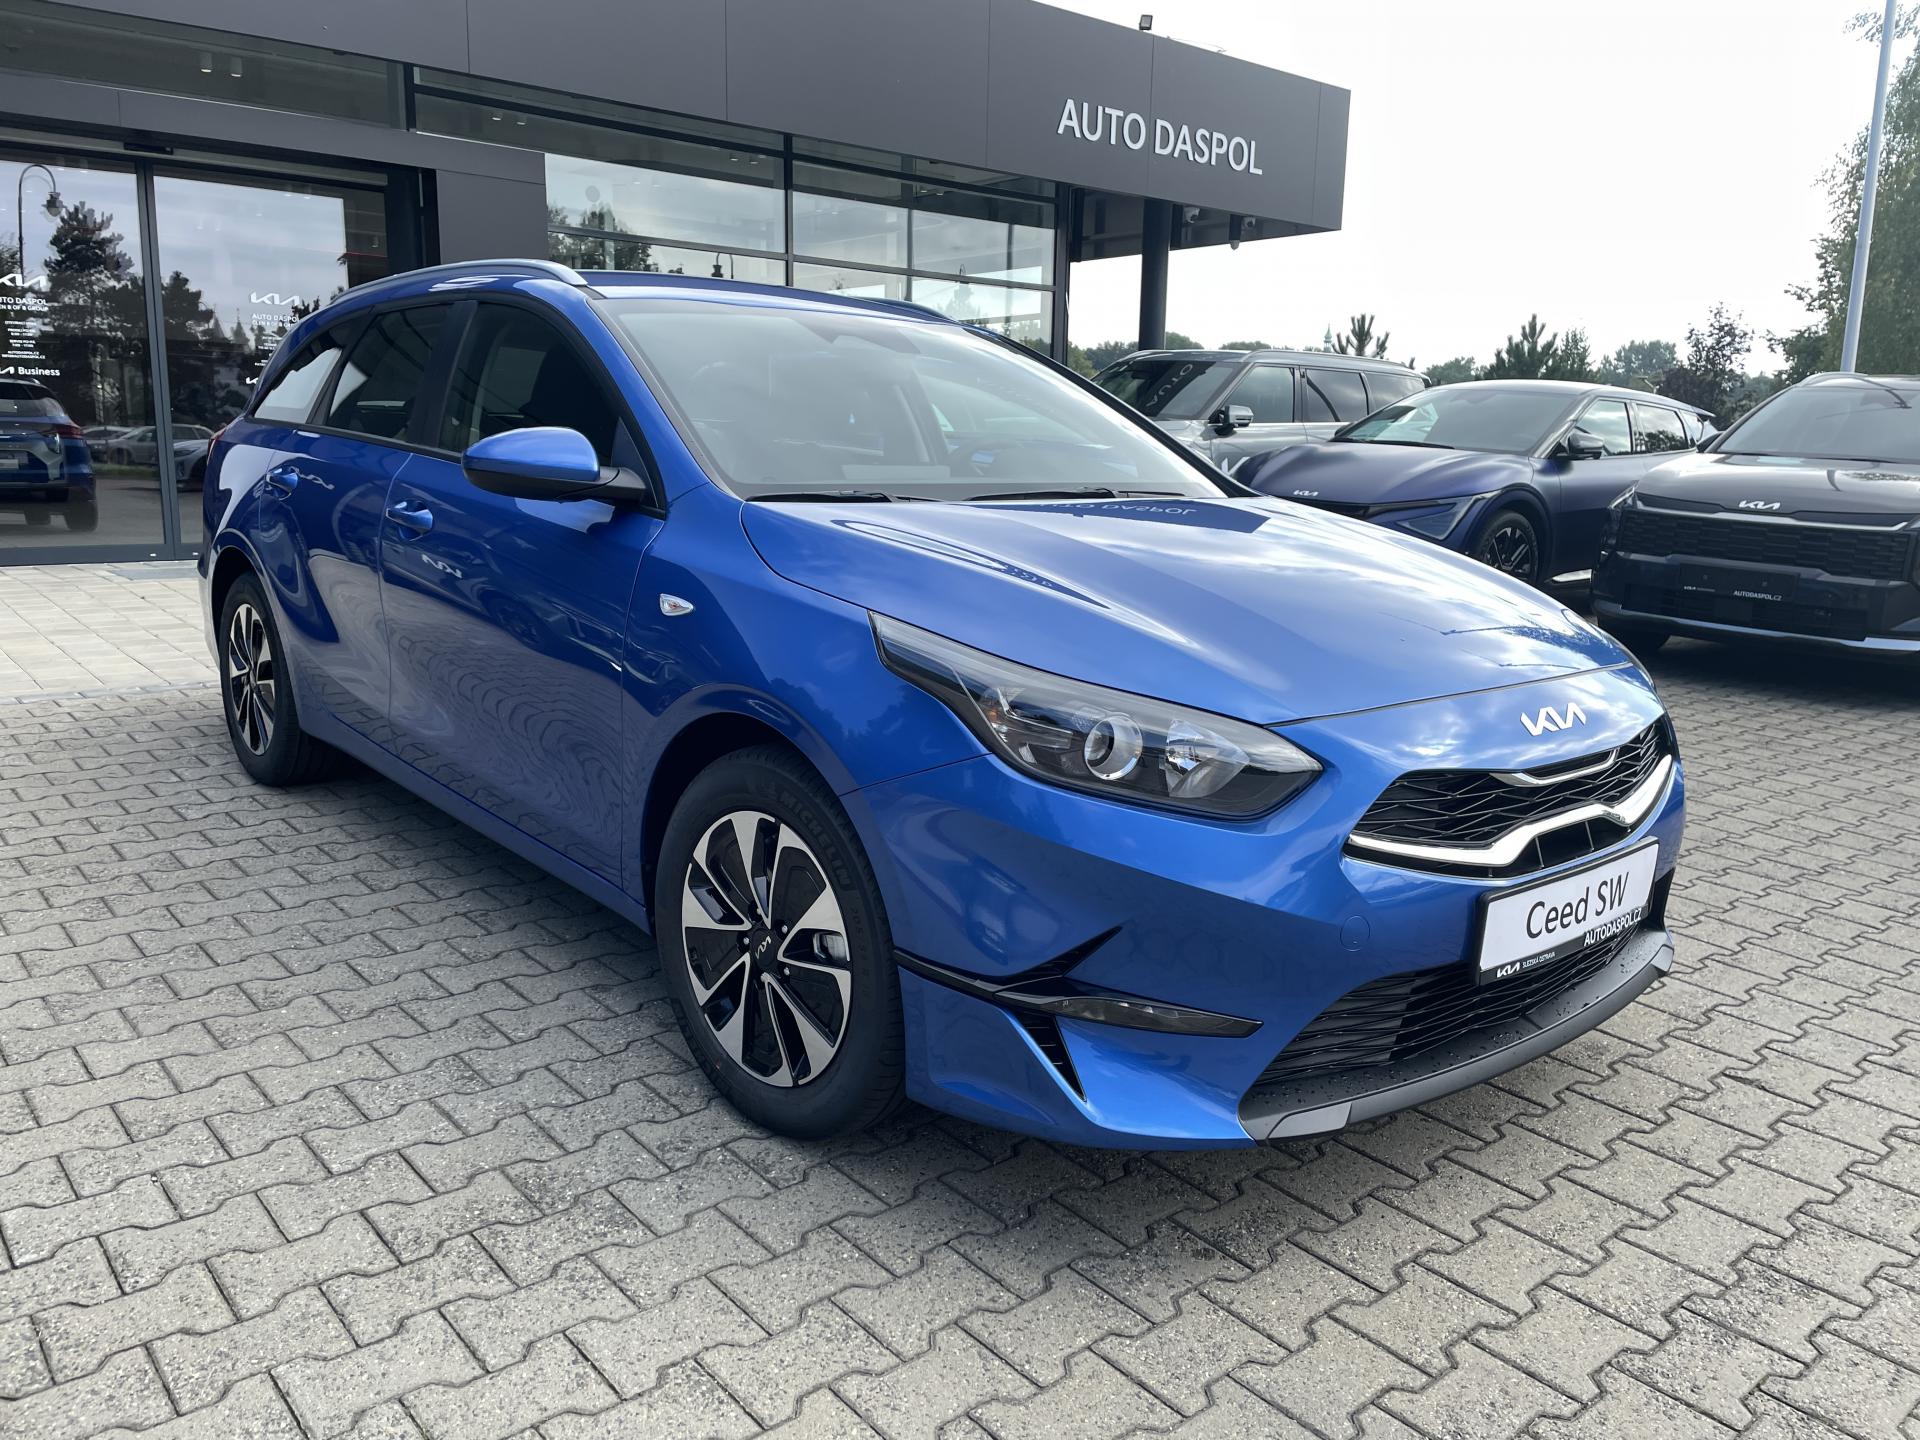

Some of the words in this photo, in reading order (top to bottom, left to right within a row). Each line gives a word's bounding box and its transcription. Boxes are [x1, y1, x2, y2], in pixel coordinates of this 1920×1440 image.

[1057, 98, 1146, 150] AUTO
[1154, 118, 1263, 175] DASPOL
[16, 297, 48, 306] DASPOL
[250, 291, 300, 305] KIA
[252, 313, 272, 321] AUTO
[18, 366, 60, 377] Business
[1293, 489, 1319, 497] KIA
[1739, 500, 1780, 510] KIA
[1520, 702, 1587, 737] KIA
[1526, 886, 1590, 939] Ceed
[1595, 871, 1630, 917] SW
[1497, 961, 1521, 978] KIA
